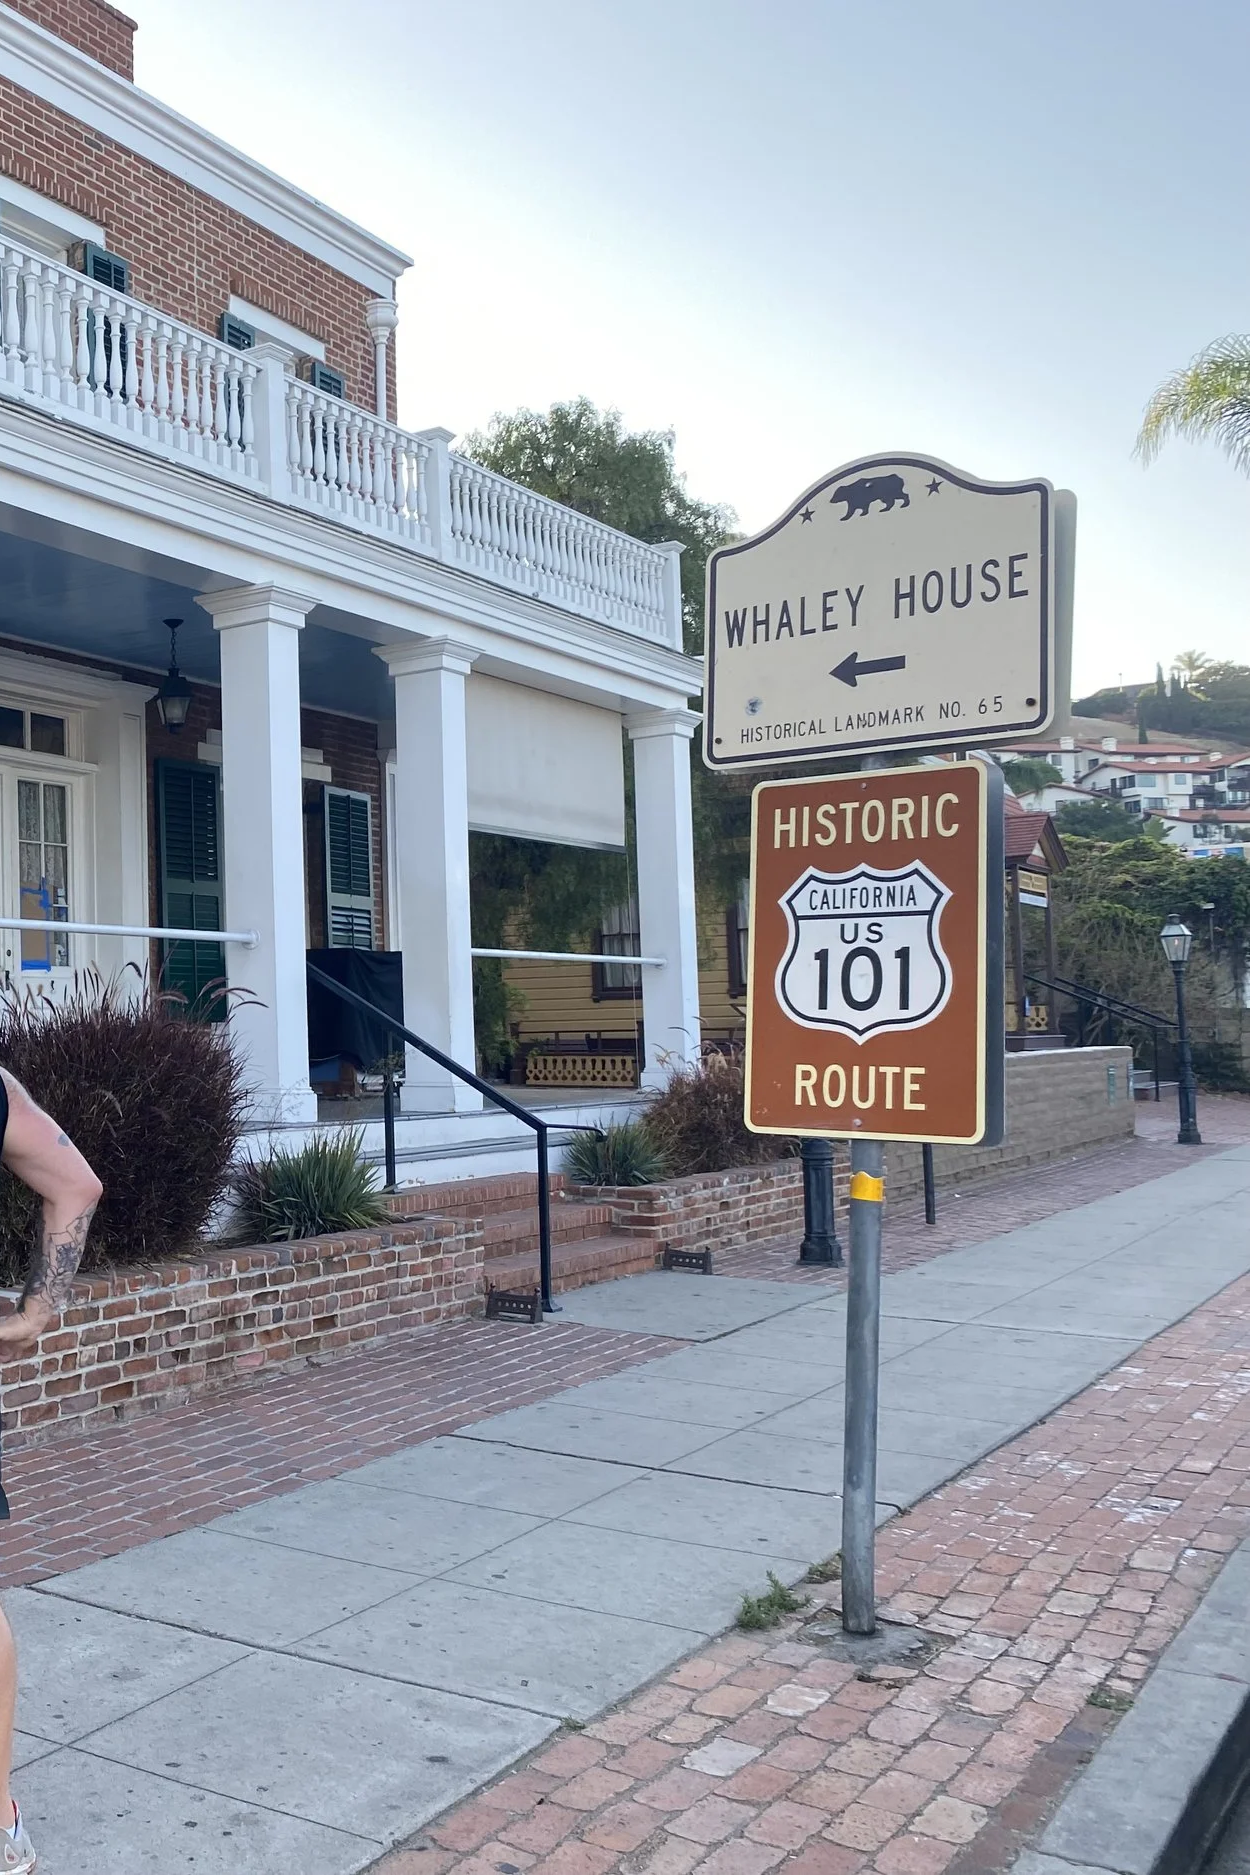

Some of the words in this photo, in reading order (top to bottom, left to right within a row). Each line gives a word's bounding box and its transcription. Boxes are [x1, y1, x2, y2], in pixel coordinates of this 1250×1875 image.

[725, 584, 865, 649] WHALEY
[893, 552, 1030, 620] HOUSE
[740, 718, 827, 744] HISTORICAL
[834, 705, 925, 732] LANDMARK
[939, 701, 967, 719] NO.
[978, 695, 1003, 714] 65
[772, 792, 960, 849] HISTORIC
[809, 885, 918, 911] CALIFORNIA
[839, 922, 884, 944] US
[813, 945, 911, 1012] 101
[794, 1063, 926, 1111] ROUTE
